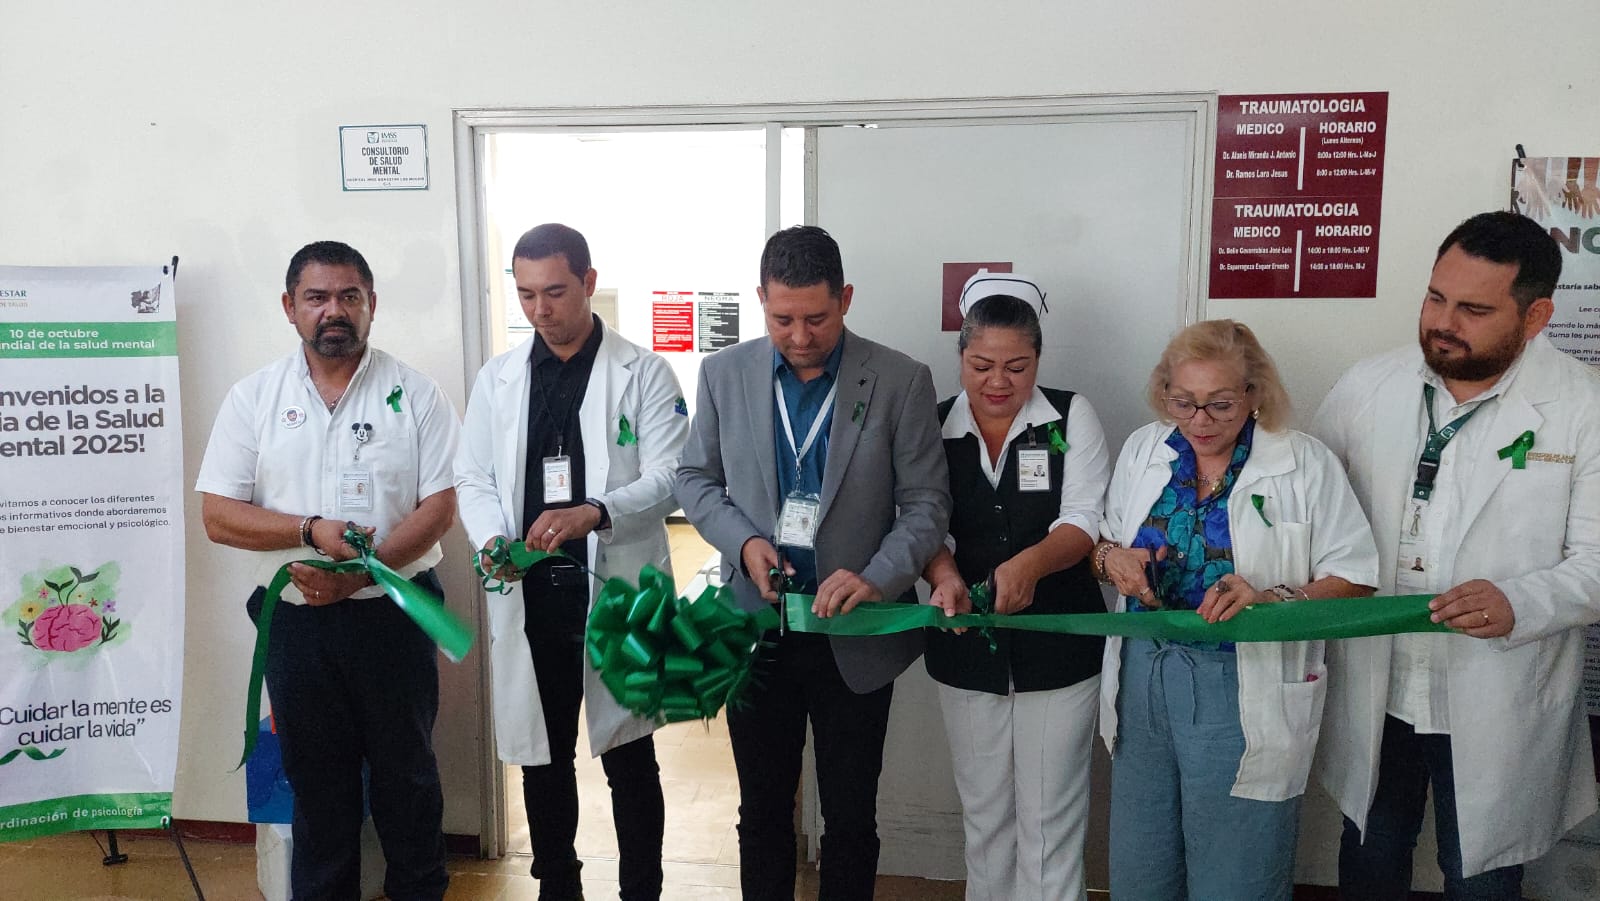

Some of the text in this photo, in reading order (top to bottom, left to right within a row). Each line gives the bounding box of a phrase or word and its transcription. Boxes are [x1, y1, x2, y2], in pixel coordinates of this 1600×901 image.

[1240, 99, 1366, 114] TRAUMATOLOGIA
[1236, 123, 1284, 135] MEDICO
[1319, 122, 1376, 133] HORARIO
[361, 146, 409, 156] CONSULTORIO
[369, 156, 403, 166] DE SALUD
[372, 166, 400, 175] MENTAL
[1226, 170, 1234, 178] Dr.
[1235, 170, 1255, 178] Ramos
[1256, 169, 1270, 178] Lara
[1235, 203, 1359, 218] TRAUMATOLOGIA
[1233, 226, 1281, 238] MEDICO
[1315, 225, 1372, 237] HORARIO
[9, 328, 99, 338] 10 de octubre
[0, 339, 156, 350] ndial de la salud mental
[124, 388, 139, 403] a
[145, 384, 165, 403] la
[25, 410, 60, 431] de
[67, 410, 89, 430] la
[95, 408, 164, 429] Salud
[72, 433, 145, 455] 2025!
[50, 498, 89, 506] conocer
[90, 496, 105, 504] los
[106, 494, 155, 503] diferentes
[9, 510, 72, 521] informativos
[74, 508, 104, 518] donde
[106, 506, 167, 516] abordaremos
[7, 524, 56, 534] bienestar
[57, 522, 107, 531] emocional
[72, 699, 90, 717] la
[93, 698, 148, 716] mente
[150, 699, 172, 713] es
[18, 723, 85, 746] cuidar
[87, 720, 103, 738] la
[72, 807, 89, 818] de
[91, 806, 144, 818] psicología
